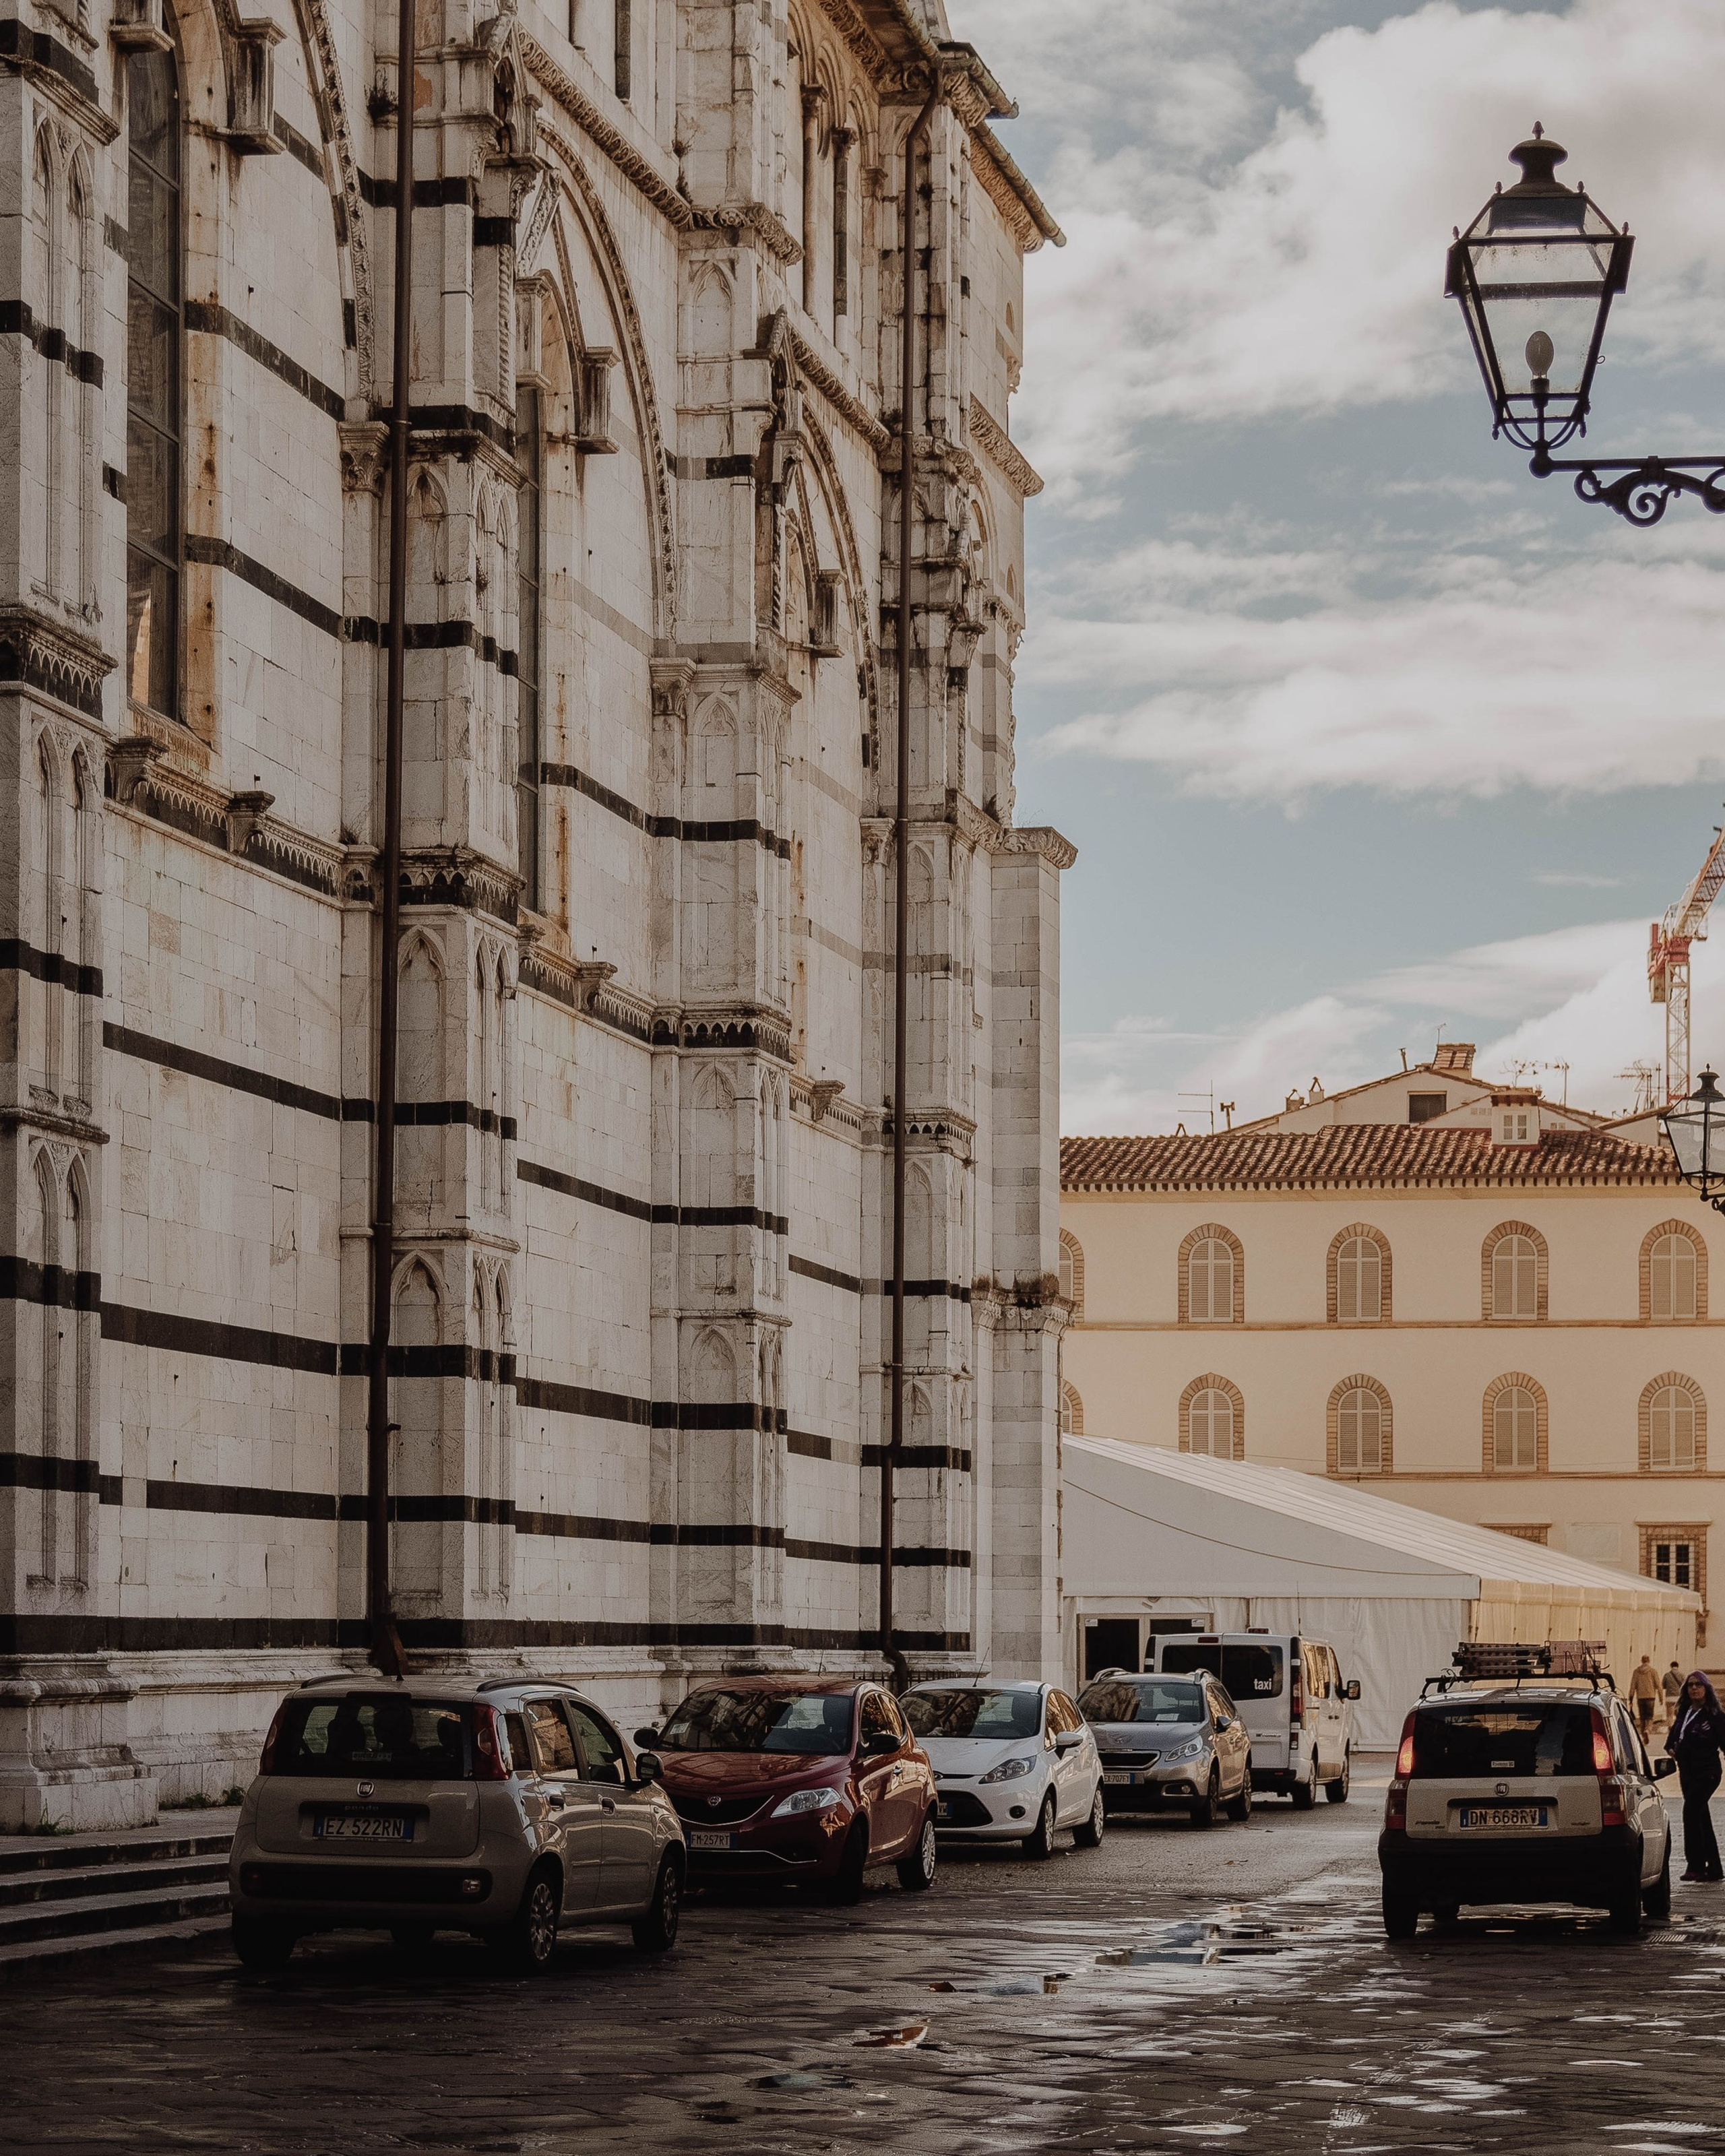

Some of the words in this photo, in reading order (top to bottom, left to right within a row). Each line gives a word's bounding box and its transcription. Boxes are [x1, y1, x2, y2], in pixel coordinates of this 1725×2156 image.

[1253, 1678, 1272, 1690] taxi
[1470, 1811, 1487, 1825] DN
[326, 1819, 346, 1835] EZ
[352, 1819, 403, 1836] 522RN
[704, 1835, 729, 1845] 257RT
